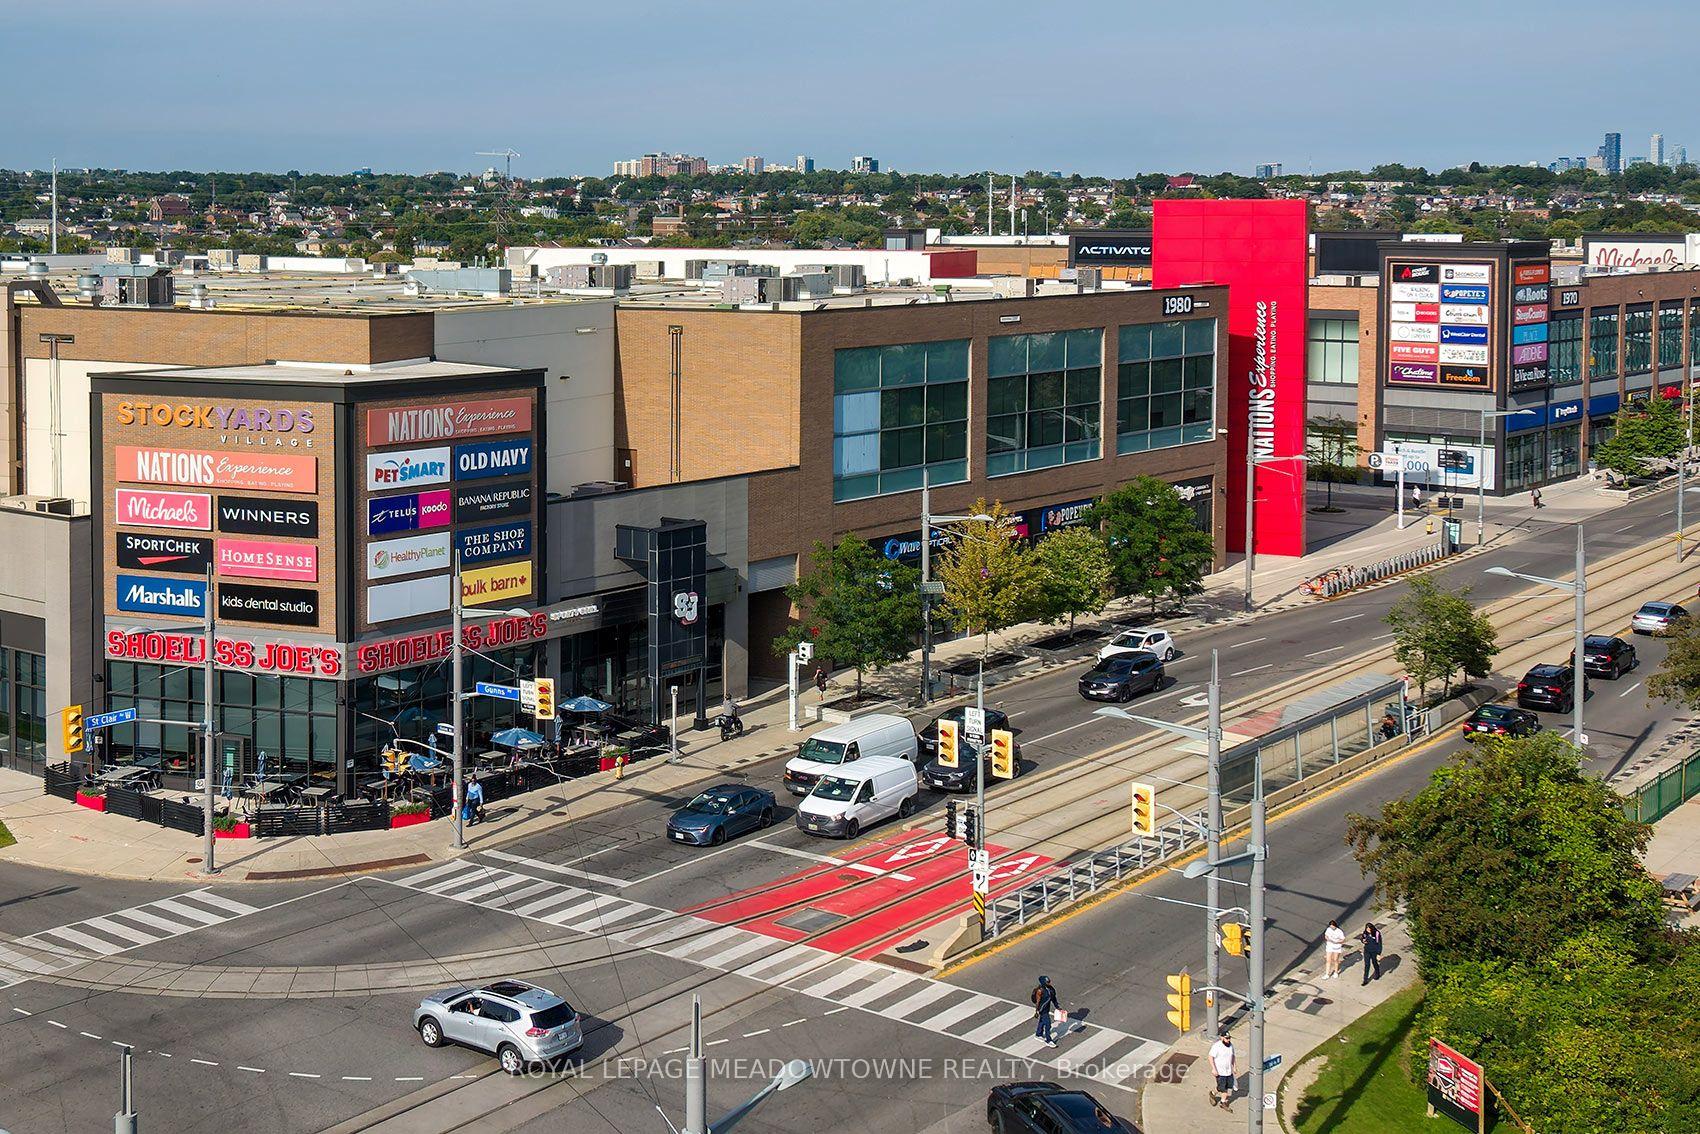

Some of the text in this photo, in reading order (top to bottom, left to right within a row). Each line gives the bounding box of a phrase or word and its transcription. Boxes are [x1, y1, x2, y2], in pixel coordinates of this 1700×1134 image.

[1595, 247, 1678, 267] Michaels
[1526, 288, 1548, 301] Roots
[1563, 291, 1578, 305] 1970
[1165, 296, 1192, 314] 1980
[1412, 347, 1436, 355] GUYS
[1249, 301, 1276, 459] NATIONS Experience
[1446, 373, 1481, 382] Freedom
[117, 401, 315, 433] STOCKYARDS
[387, 406, 516, 442] NATIONS Experience
[220, 435, 314, 448] VILLAGE
[137, 450, 293, 485] NATIONS Experience
[459, 447, 529, 472] OLD NAVY
[458, 488, 530, 507] BANANA REPUBLIC
[127, 496, 198, 523] Michaels
[223, 507, 310, 525] WINNERS
[389, 506, 418, 519] TELUS
[464, 527, 525, 546] THE SHOE
[464, 539, 525, 558] COMPANY
[490, 575, 518, 591] barn
[125, 584, 201, 608] Marshalls
[222, 595, 314, 614] kids dental studio
[487, 612, 548, 648] JOE'S
[258, 642, 341, 675] JOE'S
[485, 685, 505, 696] Gunns
[91, 717, 99, 726] St
[101, 715, 117, 725] Clair
[124, 711, 131, 719] W
